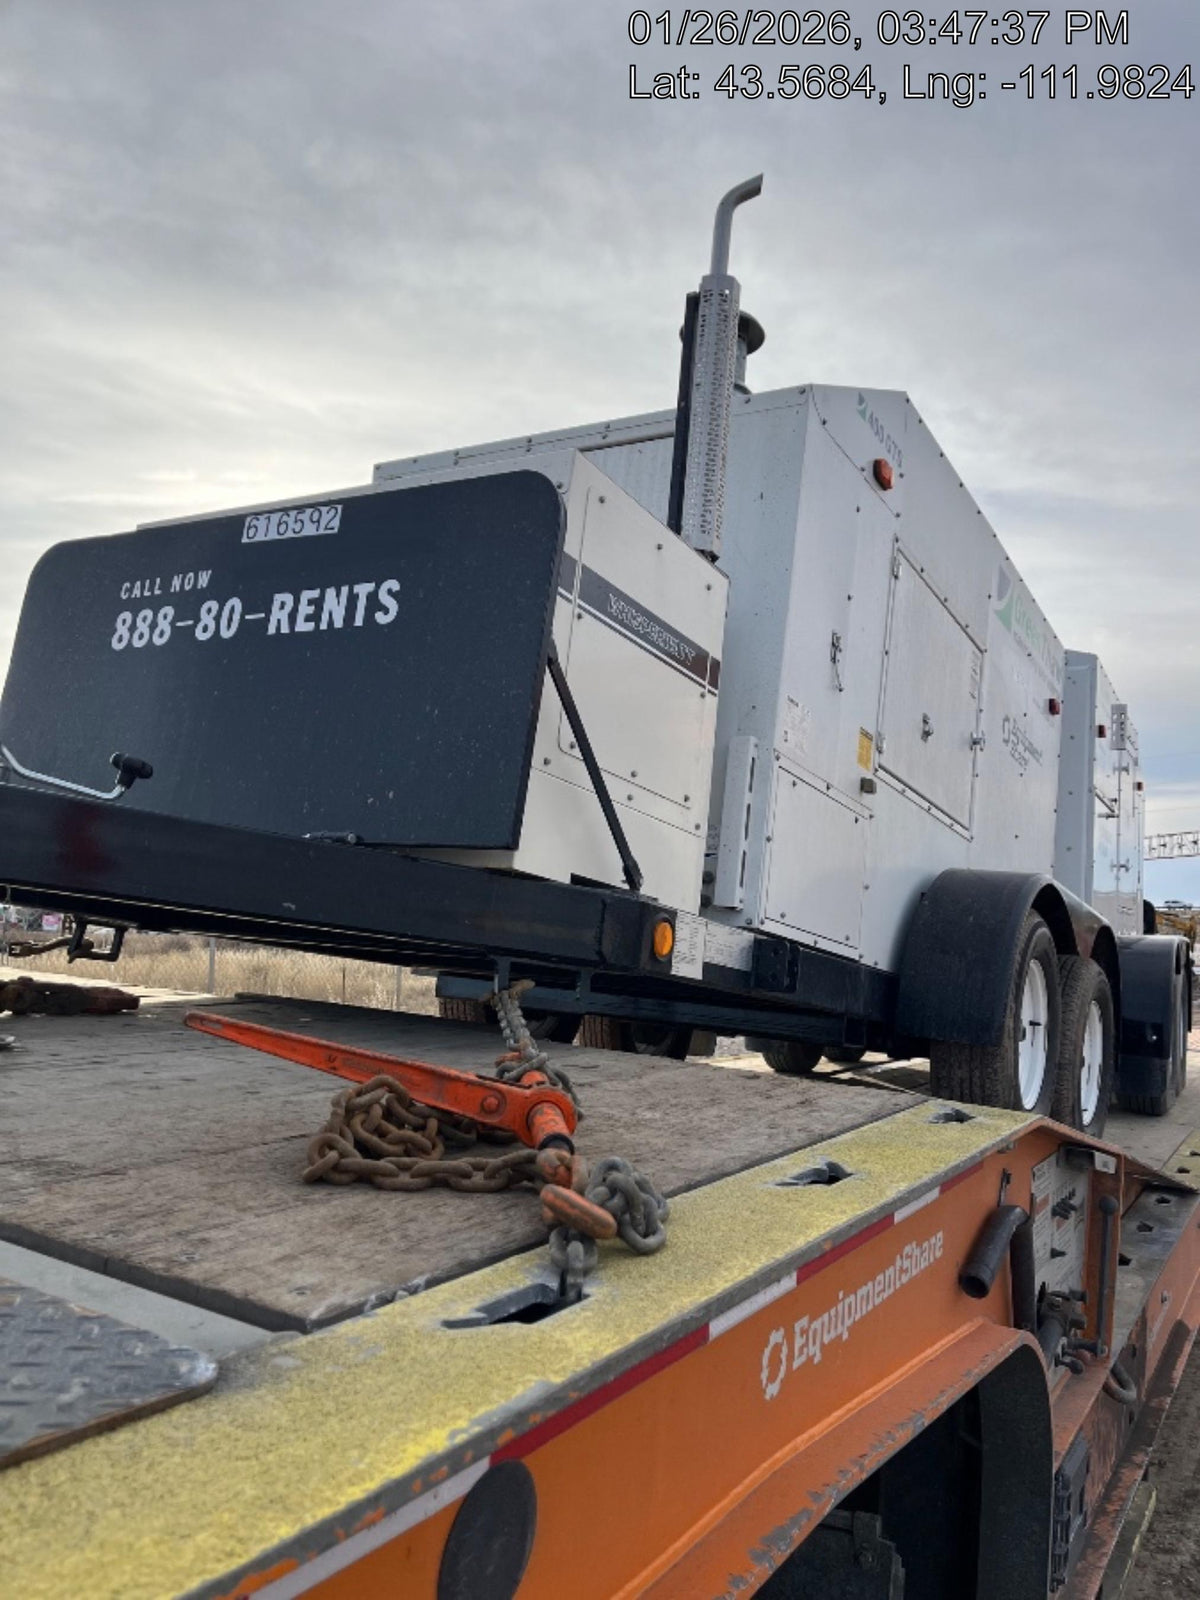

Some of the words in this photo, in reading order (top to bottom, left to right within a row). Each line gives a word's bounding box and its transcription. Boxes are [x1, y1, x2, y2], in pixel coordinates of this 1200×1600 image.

[245, 506, 339, 540] 616592
[120, 576, 163, 600] CALL
[170, 569, 212, 593] NOW
[111, 579, 400, 651] 888-80-RENTS
[793, 1230, 943, 1371] EquipmentShare
